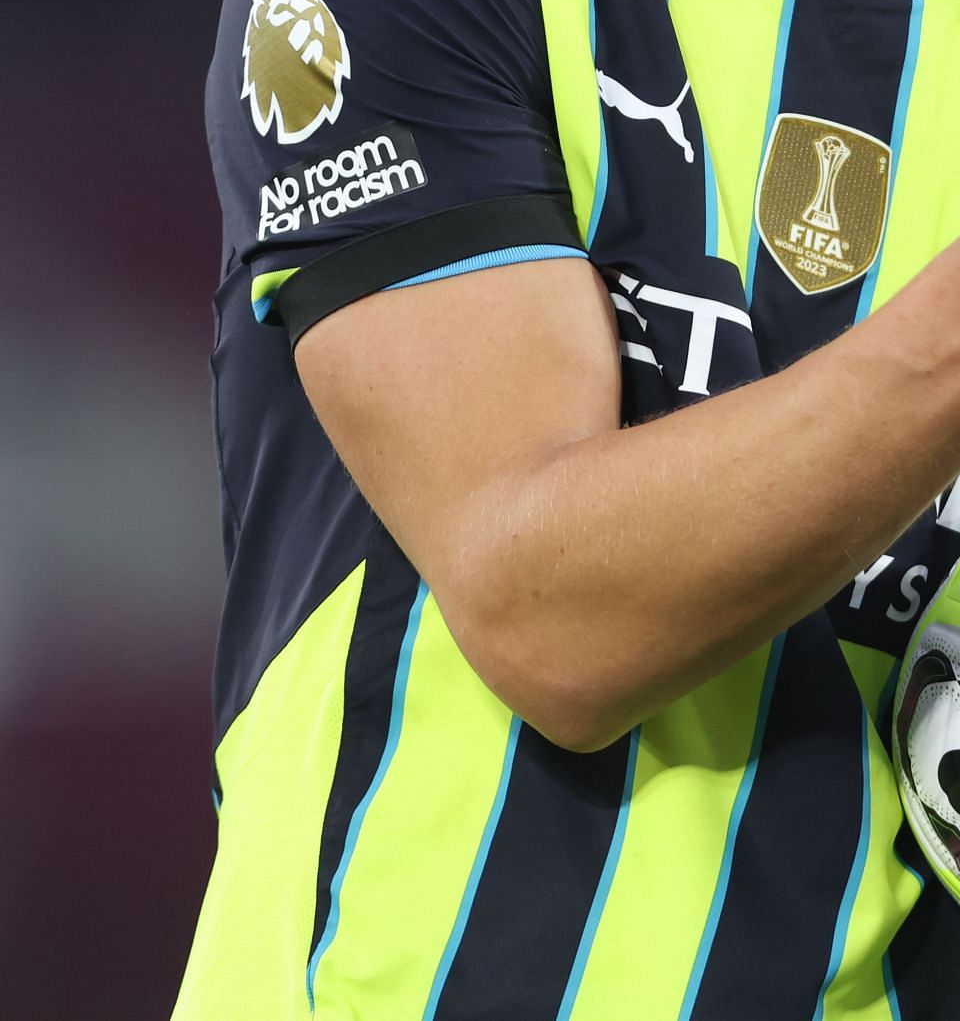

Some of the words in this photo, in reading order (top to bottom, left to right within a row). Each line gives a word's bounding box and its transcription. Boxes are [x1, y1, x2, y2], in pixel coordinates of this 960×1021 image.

[257, 204, 304, 241] for
[309, 159, 425, 225] racism
[260, 176, 300, 216] No
[303, 135, 398, 196] room
[775, 239, 804, 254] WORLD
[805, 250, 855, 273] CHAMPIONS
[795, 256, 828, 278] 2023
